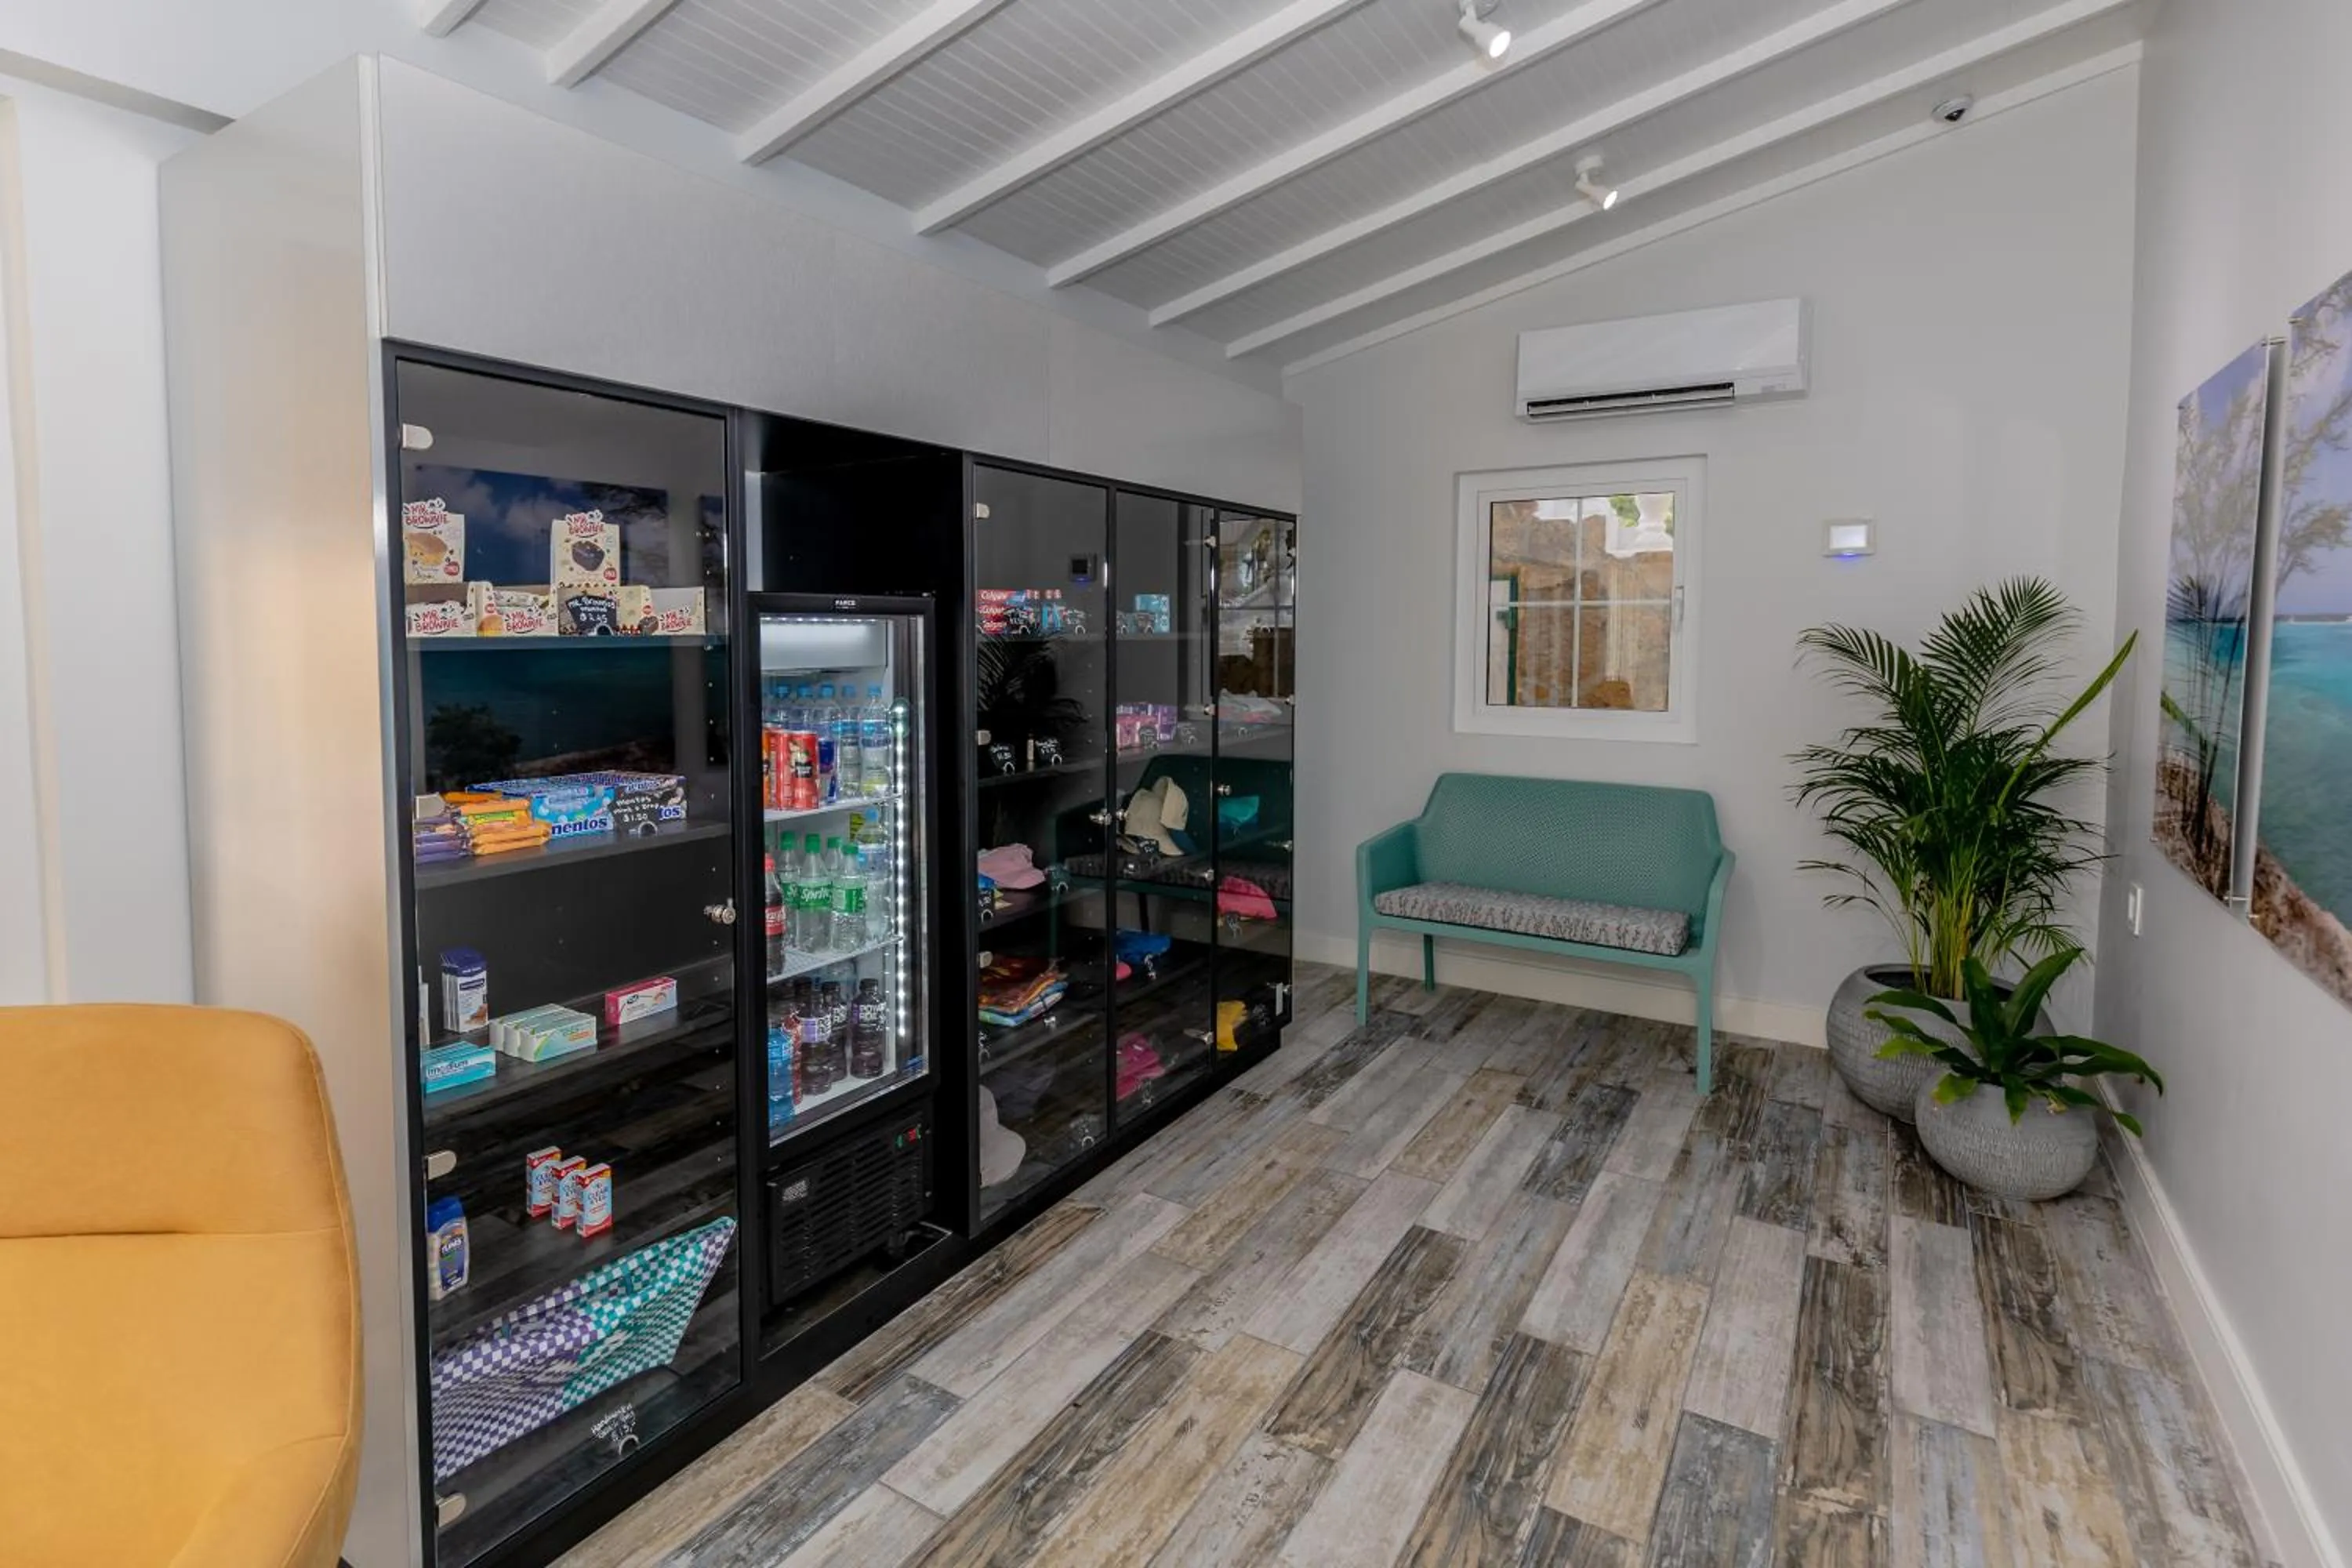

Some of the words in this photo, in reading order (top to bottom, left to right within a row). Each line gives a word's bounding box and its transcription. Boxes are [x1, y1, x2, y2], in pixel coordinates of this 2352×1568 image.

[405, 511, 448, 526] BROWNIE
[569, 522, 604, 535] BROWNIE
[416, 618, 459, 632] BROWNIE
[506, 617, 543, 631] BROWNIE
[661, 616, 693, 630] BROWNIE
